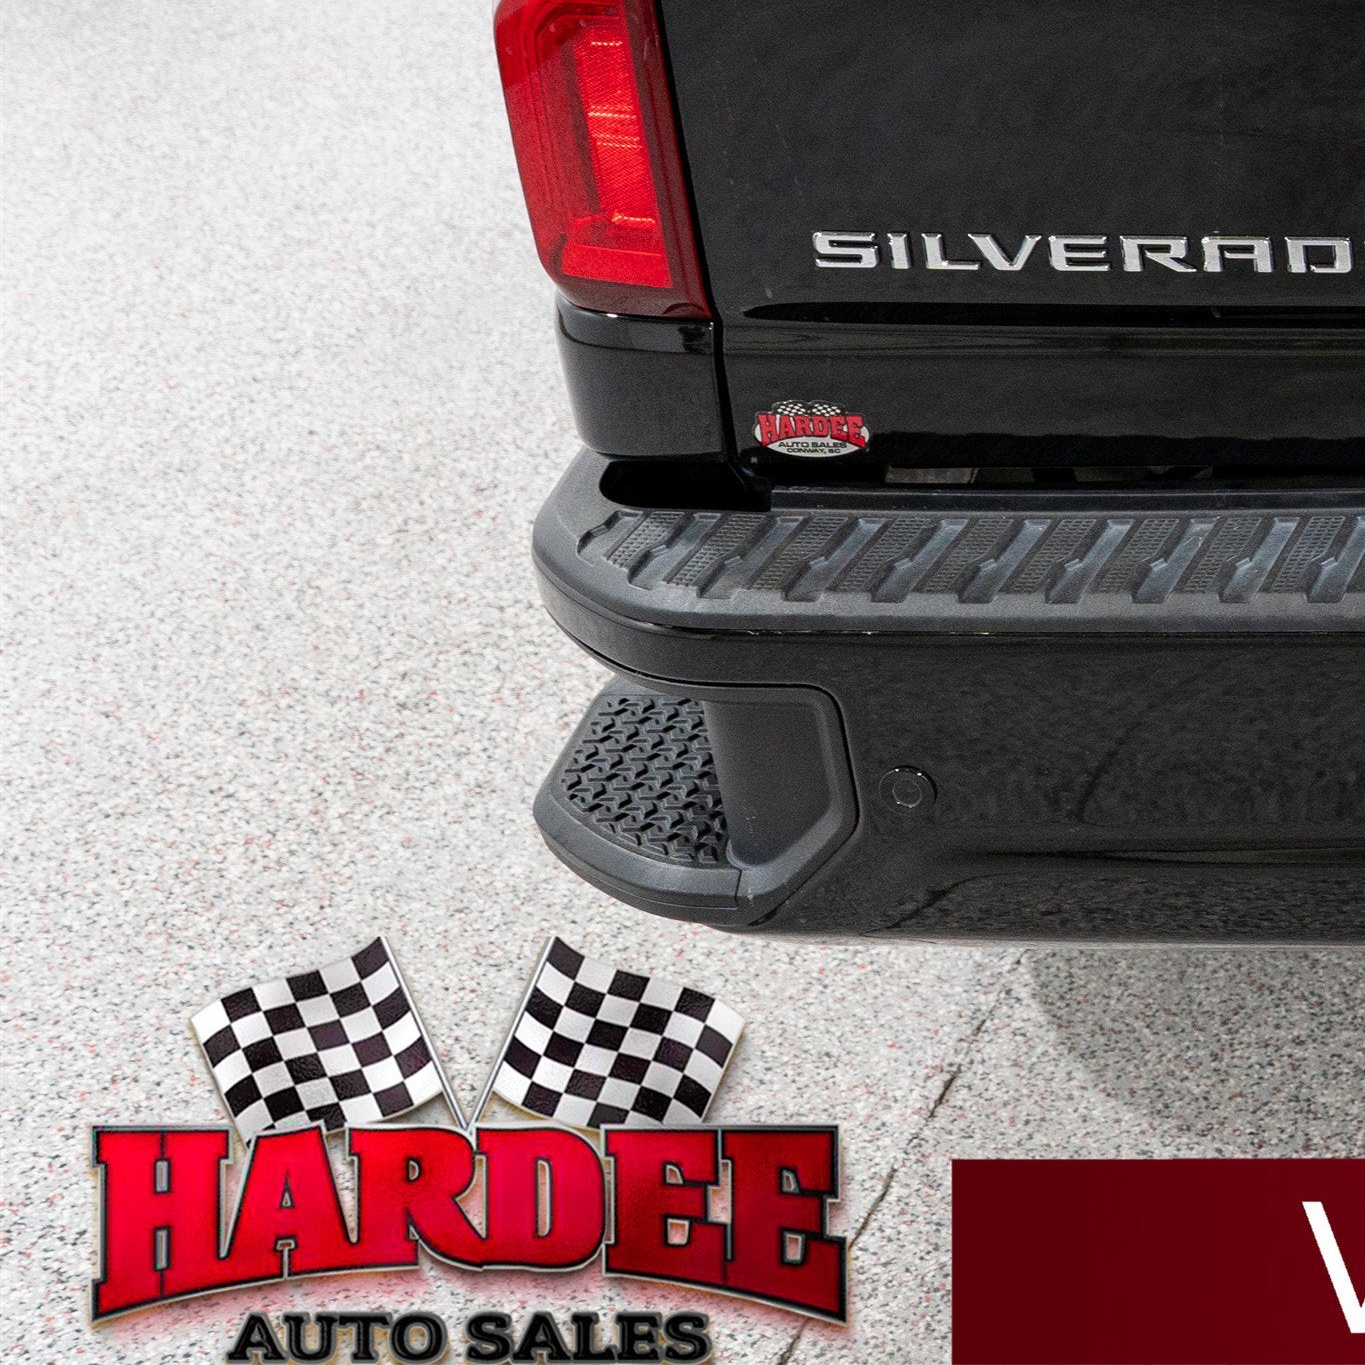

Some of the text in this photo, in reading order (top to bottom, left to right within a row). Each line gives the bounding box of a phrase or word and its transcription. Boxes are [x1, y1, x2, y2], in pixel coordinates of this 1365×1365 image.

[757, 413, 867, 448] HARDEE
[778, 441, 848, 449] AUTO SALES
[829, 447, 841, 455] SC
